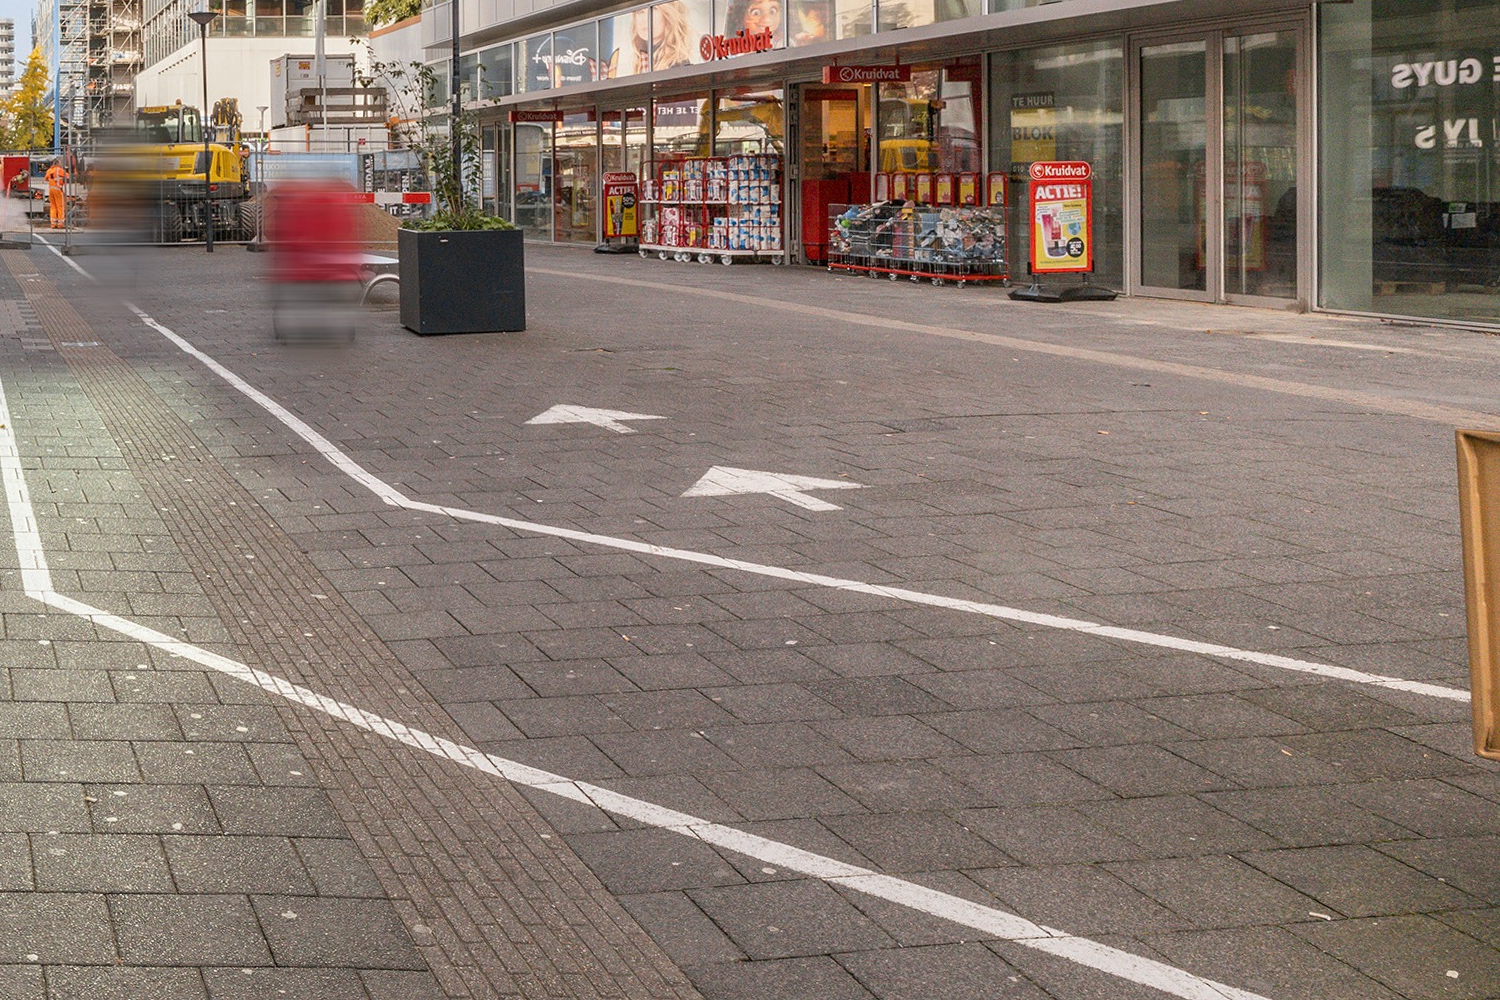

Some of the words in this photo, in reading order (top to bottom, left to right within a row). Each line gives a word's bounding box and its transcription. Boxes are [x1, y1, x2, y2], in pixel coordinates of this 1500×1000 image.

[713, 26, 773, 59] Kruidvat
[854, 68, 900, 80] Kruidvat
[1013, 98, 1025, 108] TE
[1027, 95, 1054, 107] HUUR
[527, 112, 558, 121] Kruidvat
[1012, 126, 1054, 140] BLOK
[1045, 165, 1087, 177] Kruidvat
[1035, 184, 1083, 200] ACTIE!
